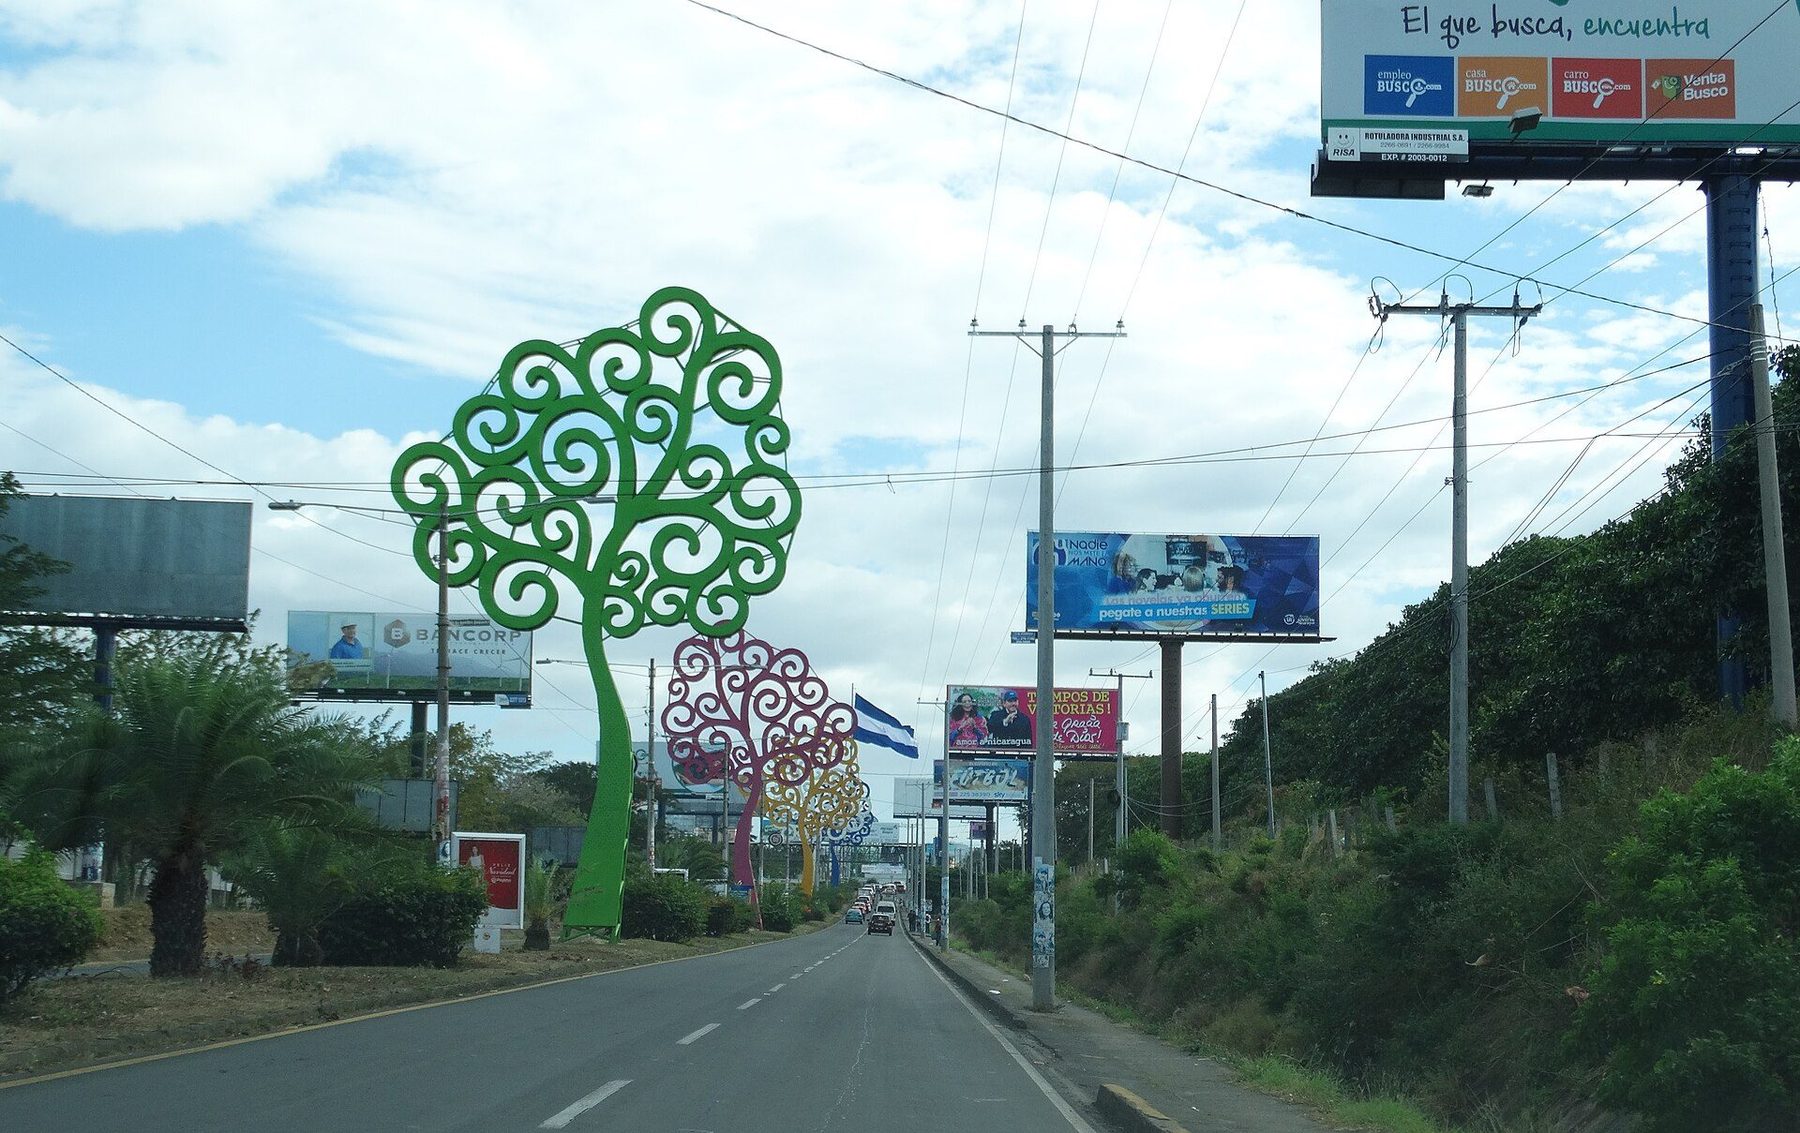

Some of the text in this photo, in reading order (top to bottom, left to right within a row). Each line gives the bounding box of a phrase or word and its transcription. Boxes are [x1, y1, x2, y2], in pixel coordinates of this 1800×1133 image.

[1401, 4, 1710, 49] El que busca, encuentra
[1377, 69, 1412, 80] empleo
[1465, 69, 1487, 78] casa
[1563, 70, 1589, 79] carro
[1683, 73, 1726, 86] Venta
[1683, 86, 1729, 101] Busco
[1364, 132, 1409, 141] ROTULADORA
[1411, 133, 1451, 141] INDUSTRIAL
[1333, 148, 1355, 157] RISA
[1381, 153, 1400, 161] EXP.
[1407, 154, 1448, 162] 2003-0012
[1069, 539, 1108, 550] Nadie
[1067, 557, 1107, 567] MANO
[1099, 603, 1250, 621] pegate a nuestras SERIES
[1027, 691, 1110, 703] TMPOS DE
[987, 738, 1032, 747] nicaragua
